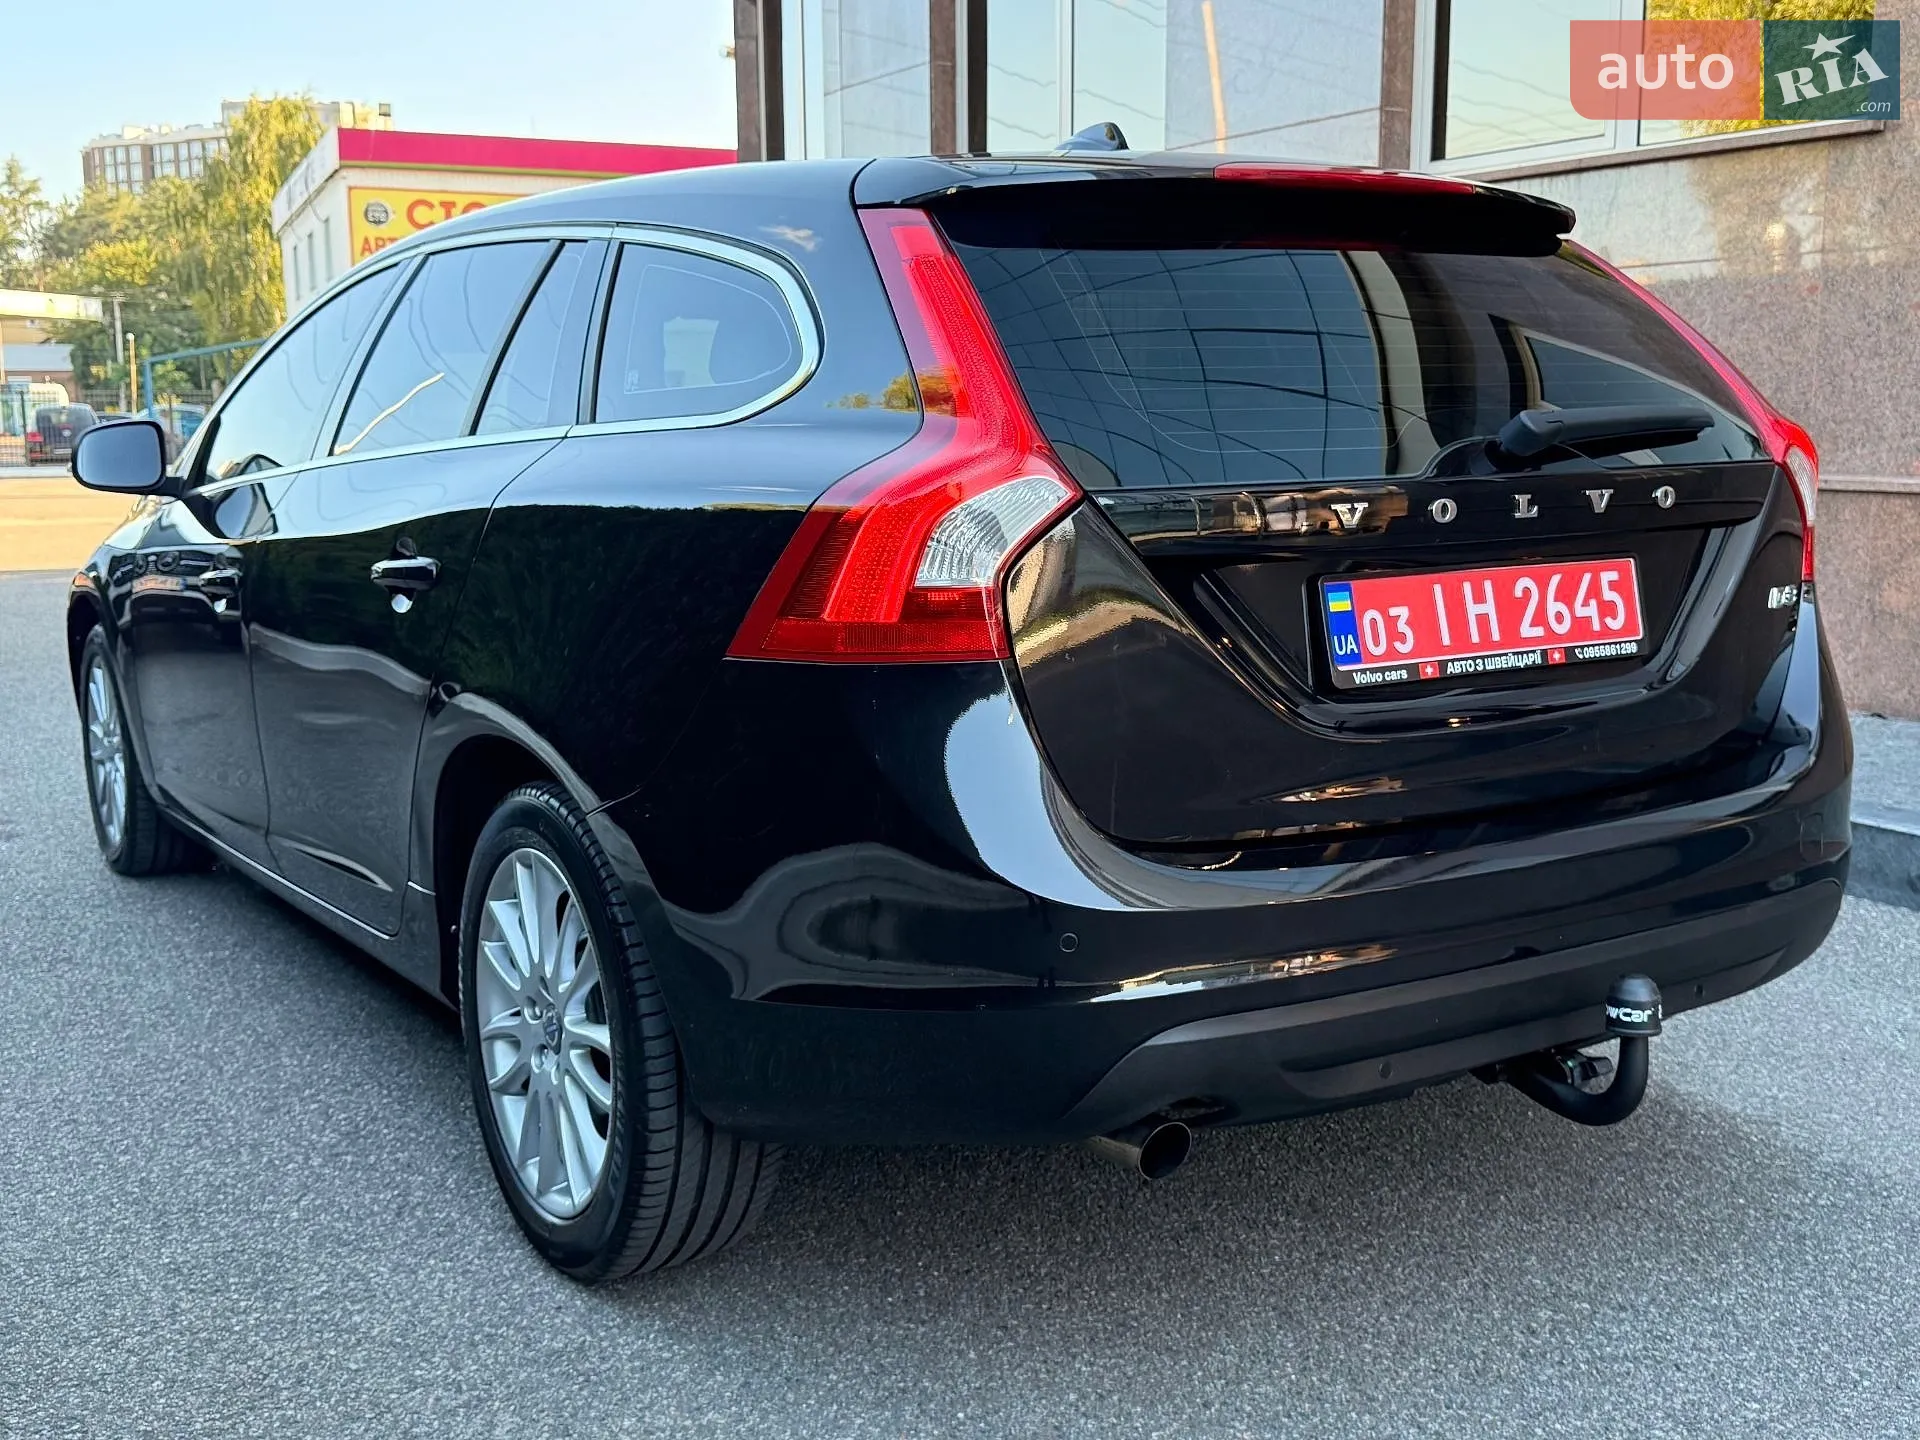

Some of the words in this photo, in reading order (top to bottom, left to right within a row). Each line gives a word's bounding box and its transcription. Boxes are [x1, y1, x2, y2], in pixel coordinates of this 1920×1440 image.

[1331, 486, 1676, 528] VOLVO
[1362, 605, 1414, 656] 03
[1514, 570, 1626, 638] 2645
[1334, 634, 1358, 656] UA
[1447, 659, 1475, 674] АВТО
[1485, 650, 1542, 669] ШВЕЙЦАРІЇ
[1353, 671, 1382, 684] Volvo
[1385, 669, 1408, 680] cars
